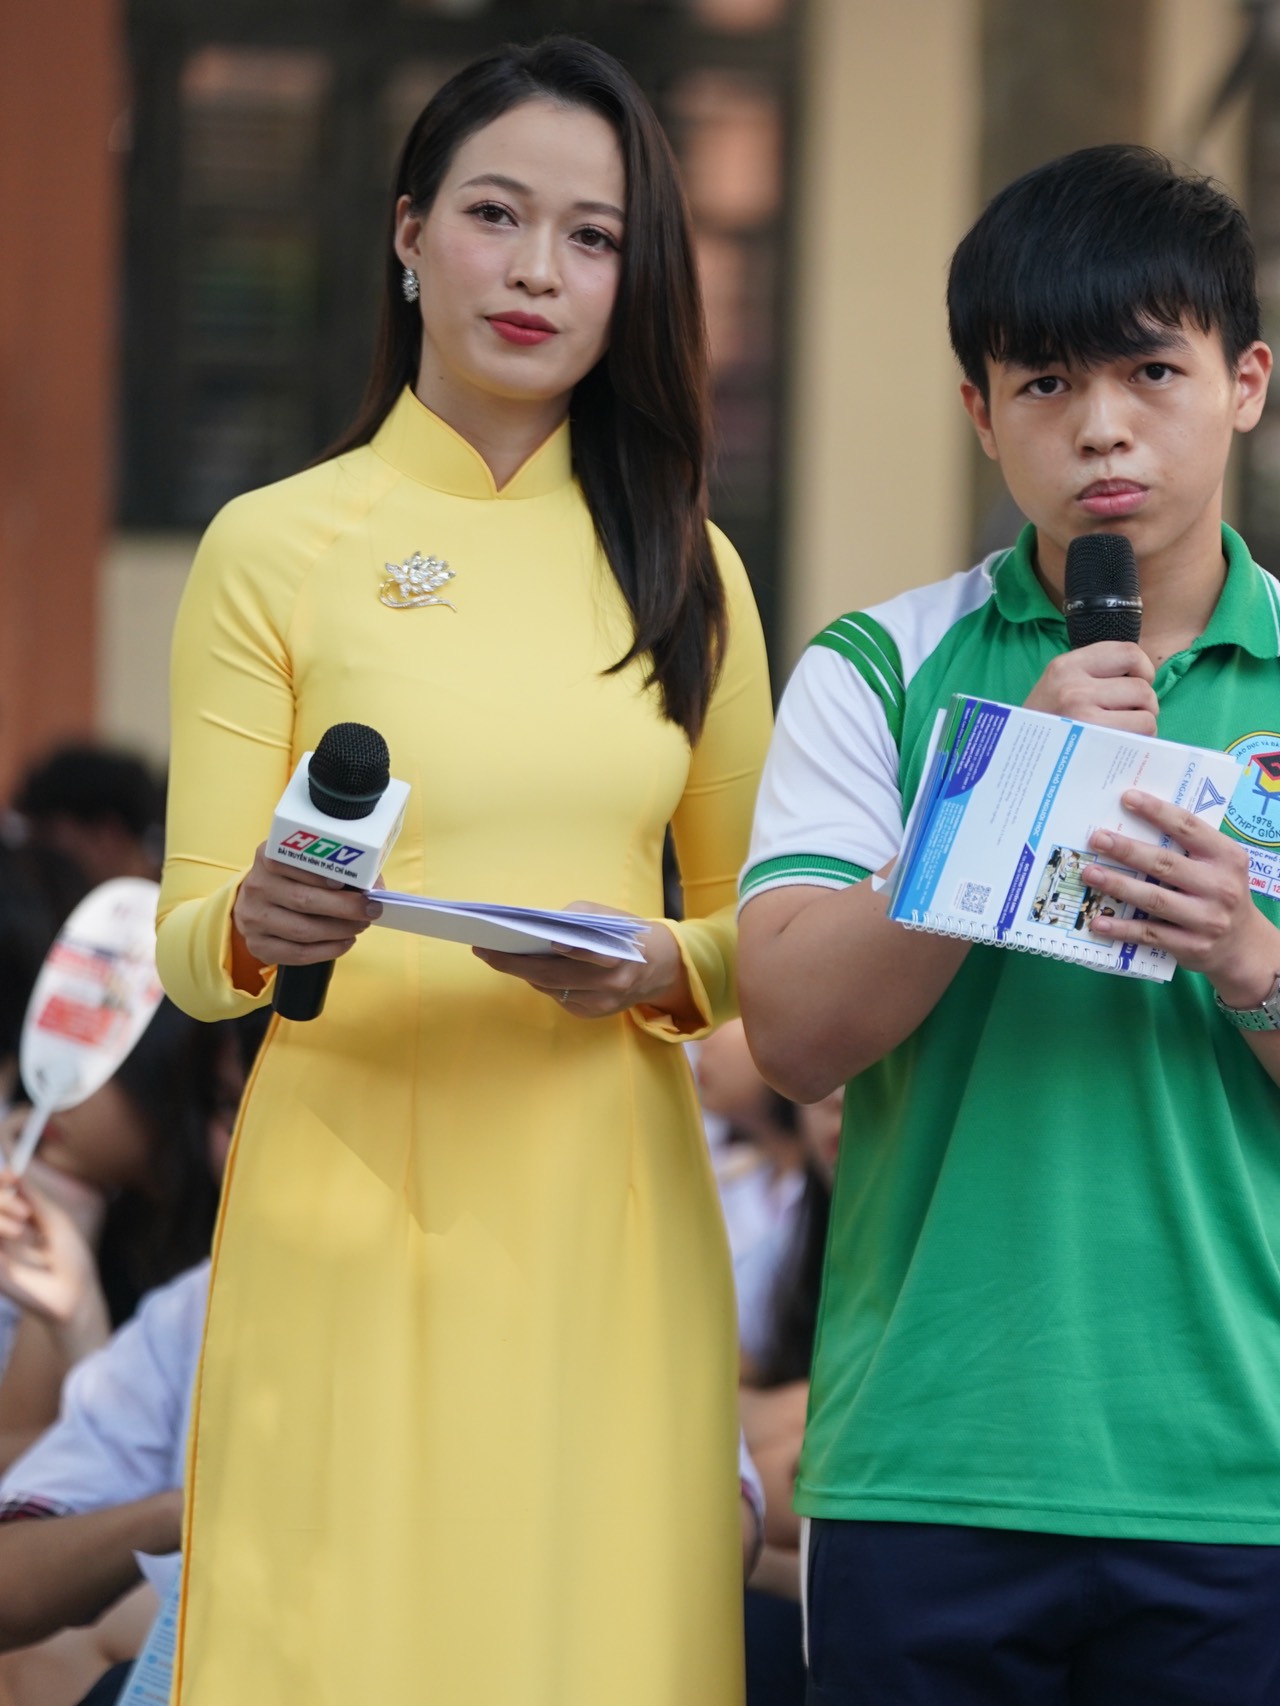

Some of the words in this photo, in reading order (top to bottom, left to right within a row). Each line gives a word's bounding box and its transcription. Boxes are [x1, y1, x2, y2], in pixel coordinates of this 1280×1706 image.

[1235, 814, 1257, 834] THPT
[1252, 814, 1272, 828] 1978
[282, 831, 363, 864] HTV
